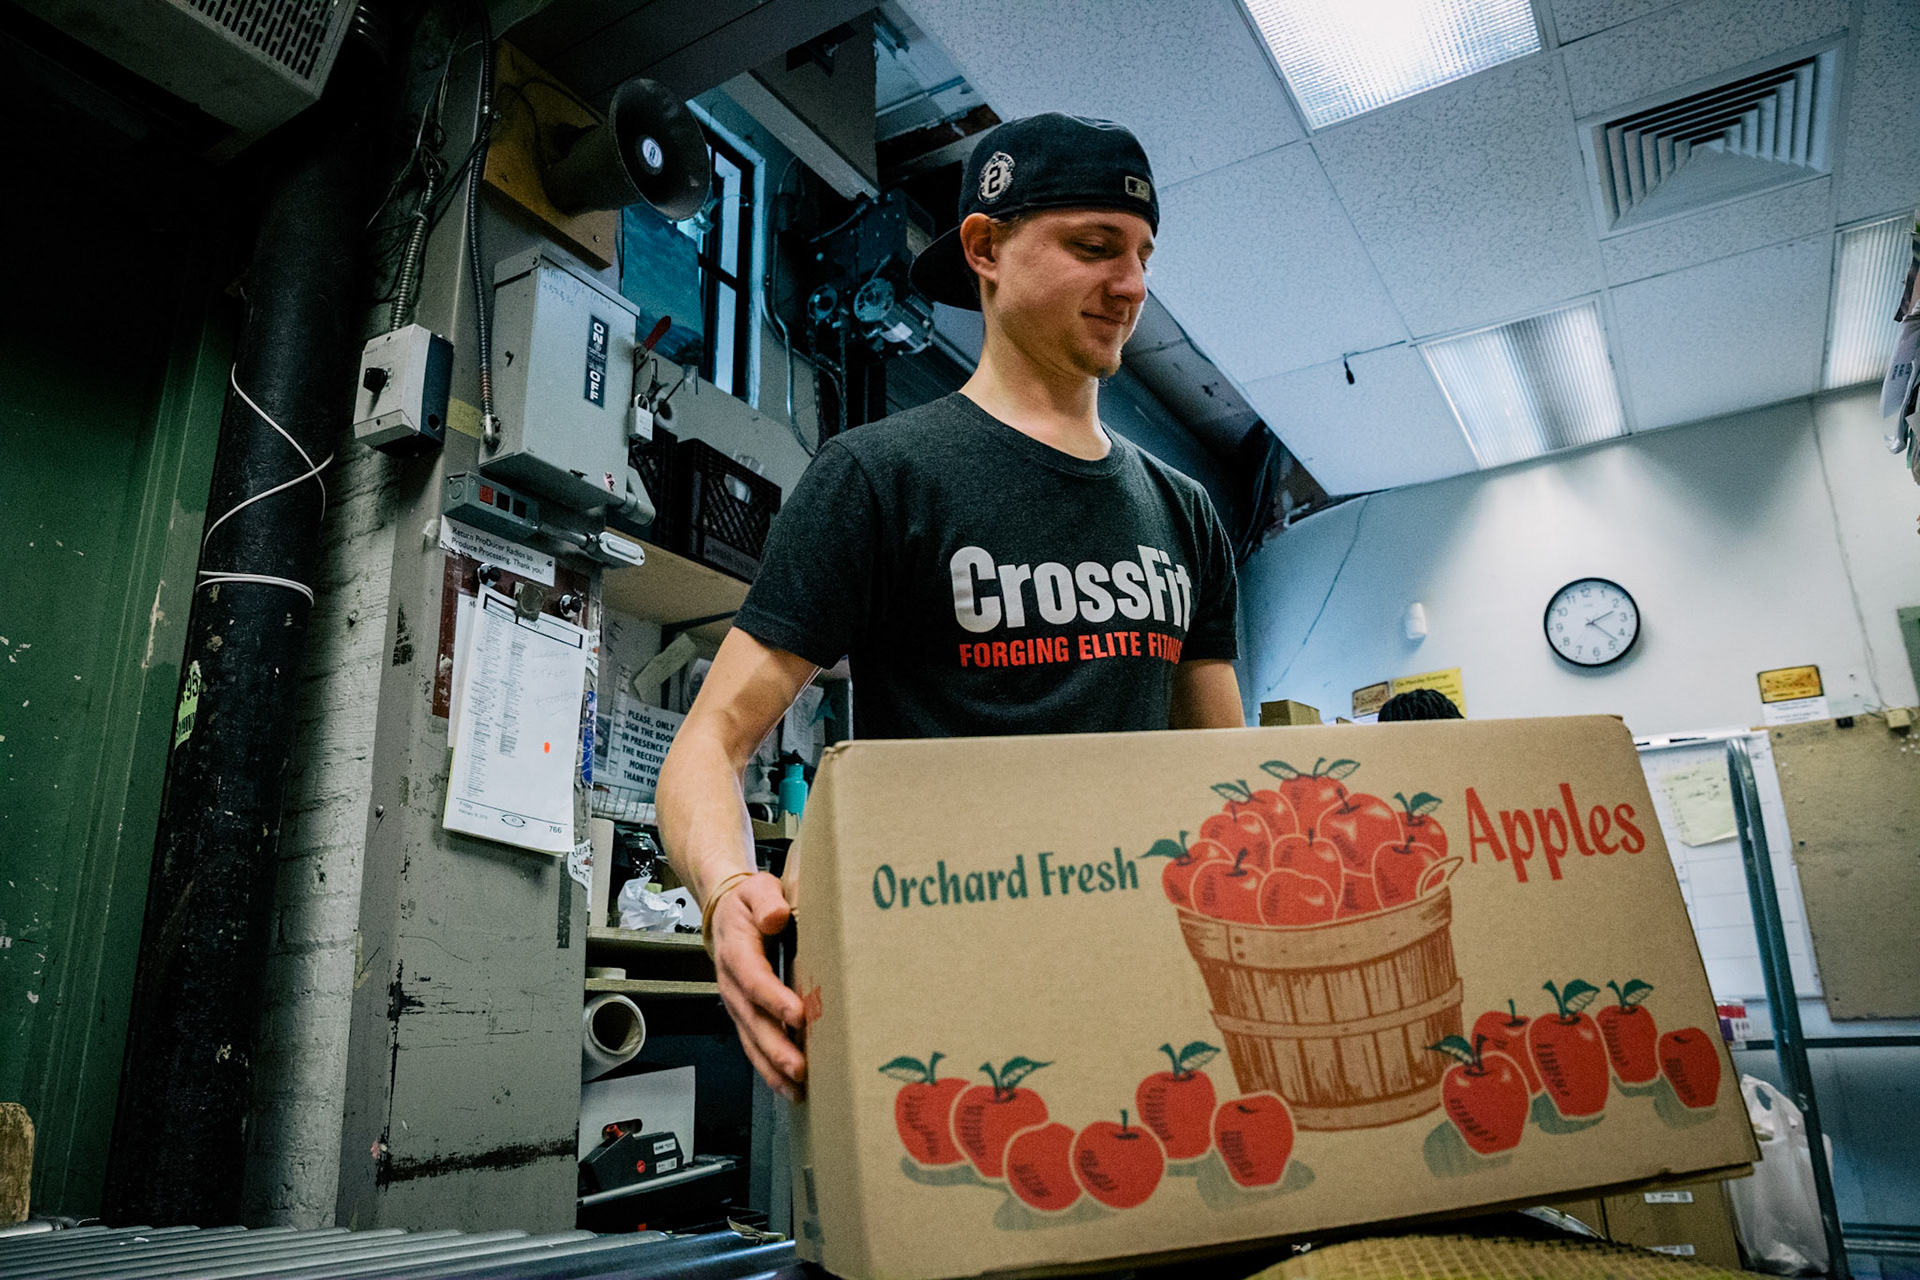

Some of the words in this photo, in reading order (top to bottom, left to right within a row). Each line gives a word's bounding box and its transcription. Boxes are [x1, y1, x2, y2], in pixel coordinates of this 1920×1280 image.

[988, 165, 1001, 195] 2
[592, 322, 605, 346] ON
[589, 370, 601, 401] OFF
[452, 526, 474, 541] Return
[475, 534, 505, 552] ProDucer
[506, 545, 526, 560] Radios
[451, 537, 478, 553] Produce
[513, 558, 531, 571] Thank
[949, 544, 1192, 633] CrossFit
[1580, 588, 1592, 598] 12
[1600, 590, 1606, 599] 1
[1566, 595, 1577, 605] 11
[1612, 598, 1620, 609] 2
[1556, 607, 1569, 617] 10
[1619, 612, 1628, 623] 3
[1555, 622, 1564, 633] 9
[1618, 628, 1626, 637] 4
[1562, 636, 1571, 647] 8
[1608, 640, 1617, 651] 5
[958, 636, 1069, 668] FORGING
[1078, 631, 1141, 661] ELITE
[1576, 645, 1584, 655] 7
[1592, 647, 1601, 657] 6
[628, 710, 654, 728] PLEASE,
[655, 720, 676, 732] ONLY
[625, 720, 640, 733] SIGN
[641, 727, 654, 739] THE
[621, 731, 630, 741] IN
[630, 736, 665, 754] PRESENCE
[622, 744, 635, 757] THE
[623, 770, 645, 784] THANK
[646, 778, 657, 788] YO
[549, 825, 562, 834] 766
[1465, 782, 1646, 883] Apples
[872, 854, 1029, 911] Orchard
[1037, 847, 1139, 897] Fresh
